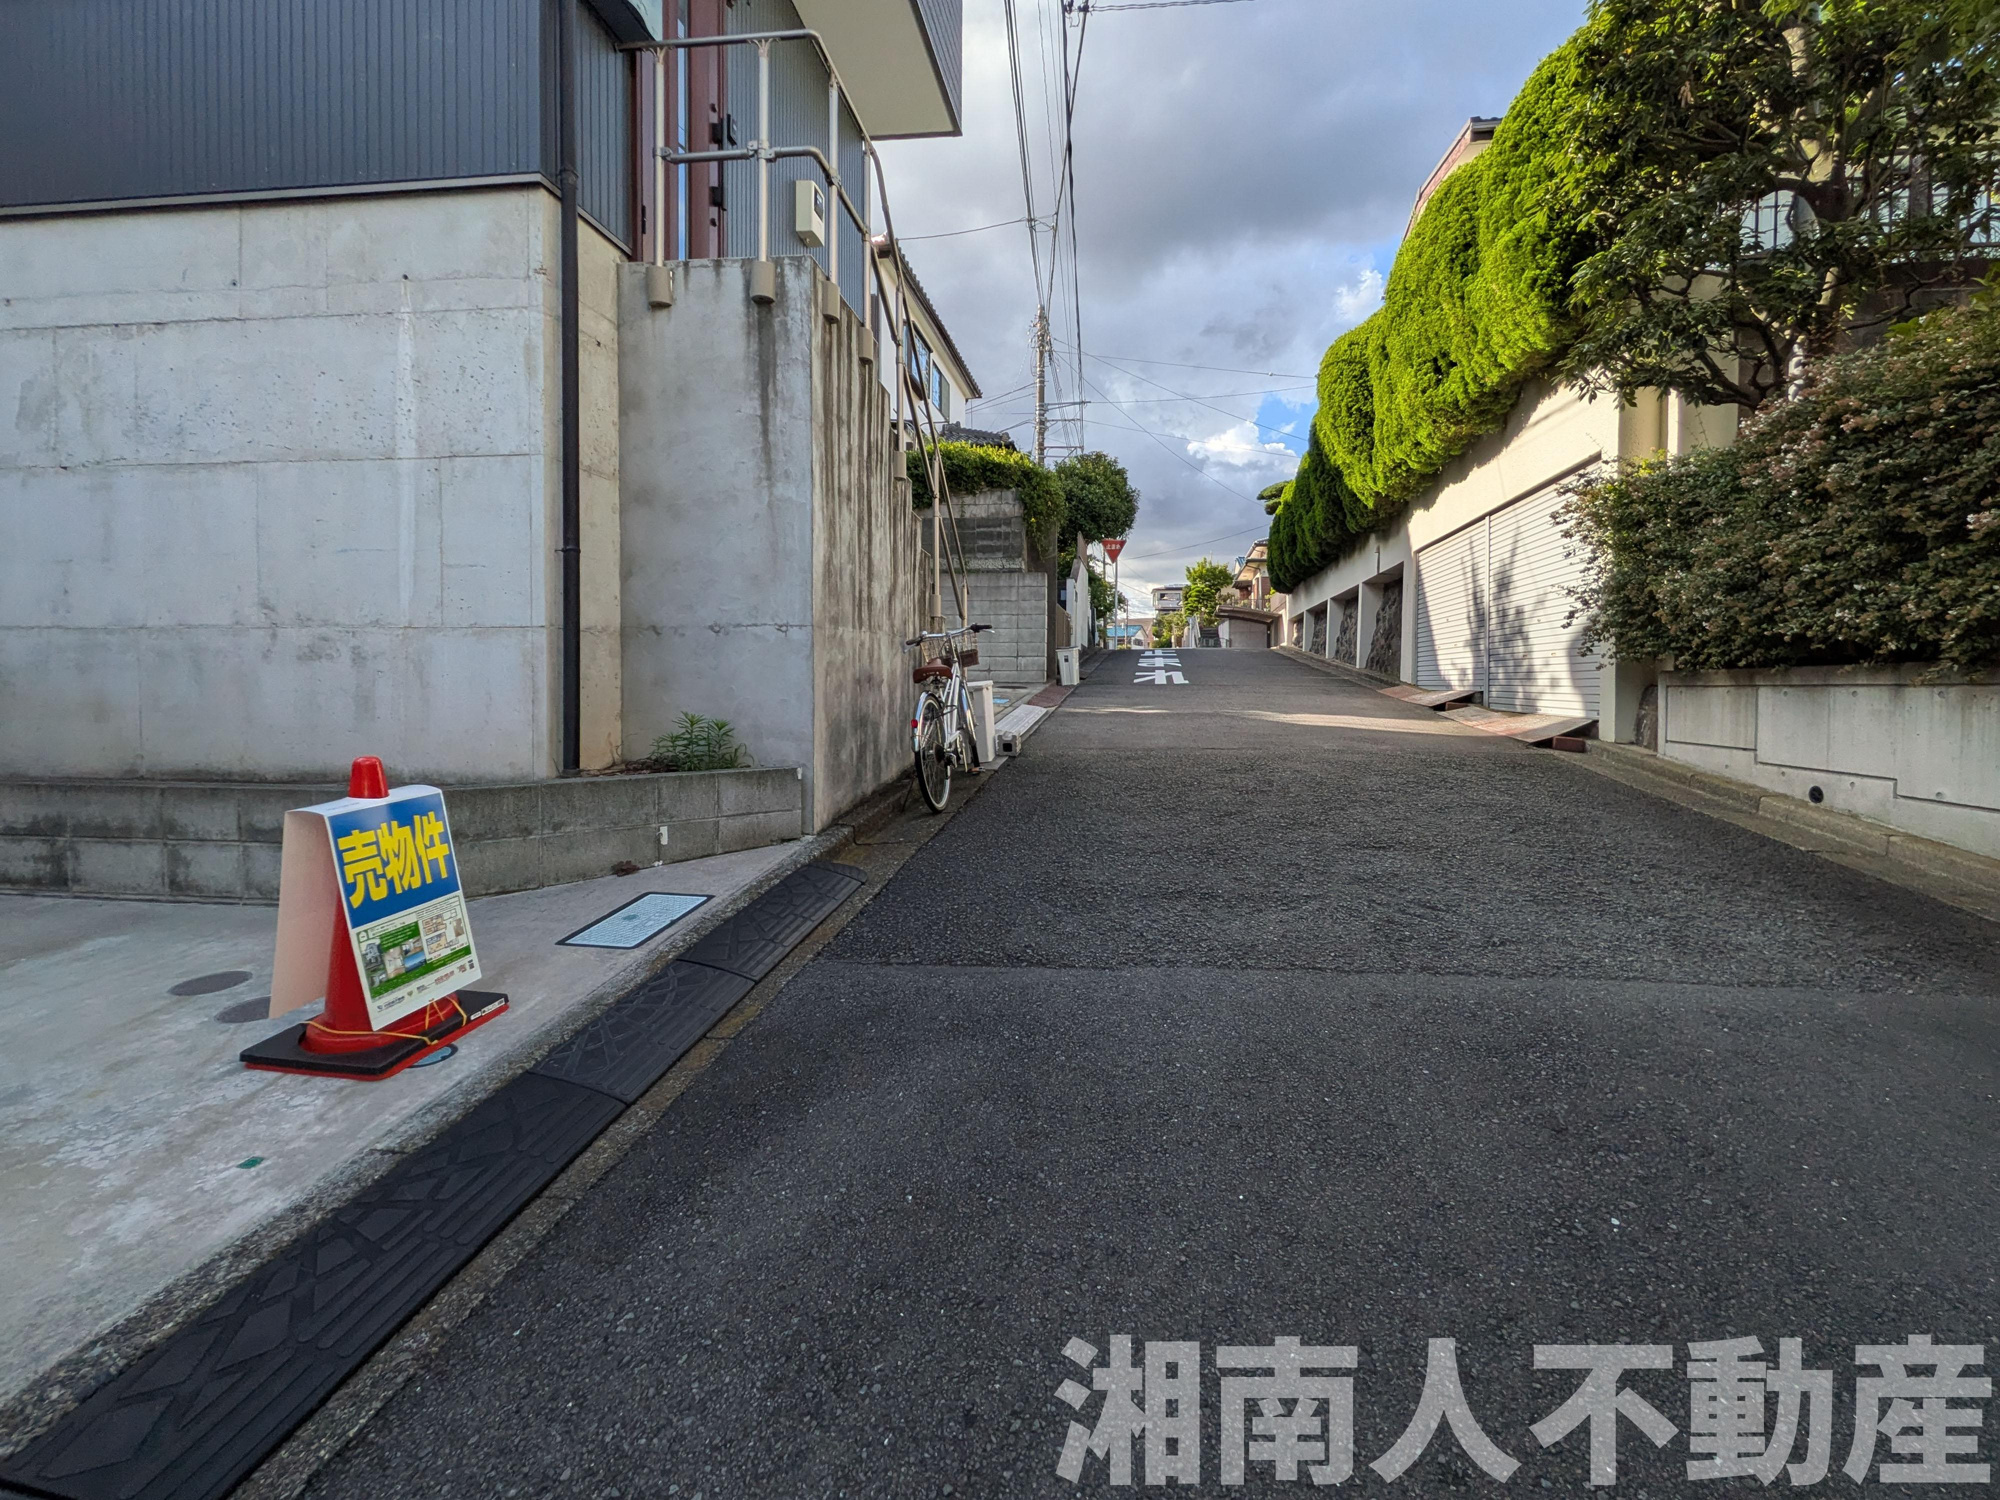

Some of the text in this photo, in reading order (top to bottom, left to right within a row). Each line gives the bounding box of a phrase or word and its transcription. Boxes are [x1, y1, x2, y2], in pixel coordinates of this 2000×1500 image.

[1133, 650, 1189, 684] 止まれ
[338, 811, 450, 909] 売物件
